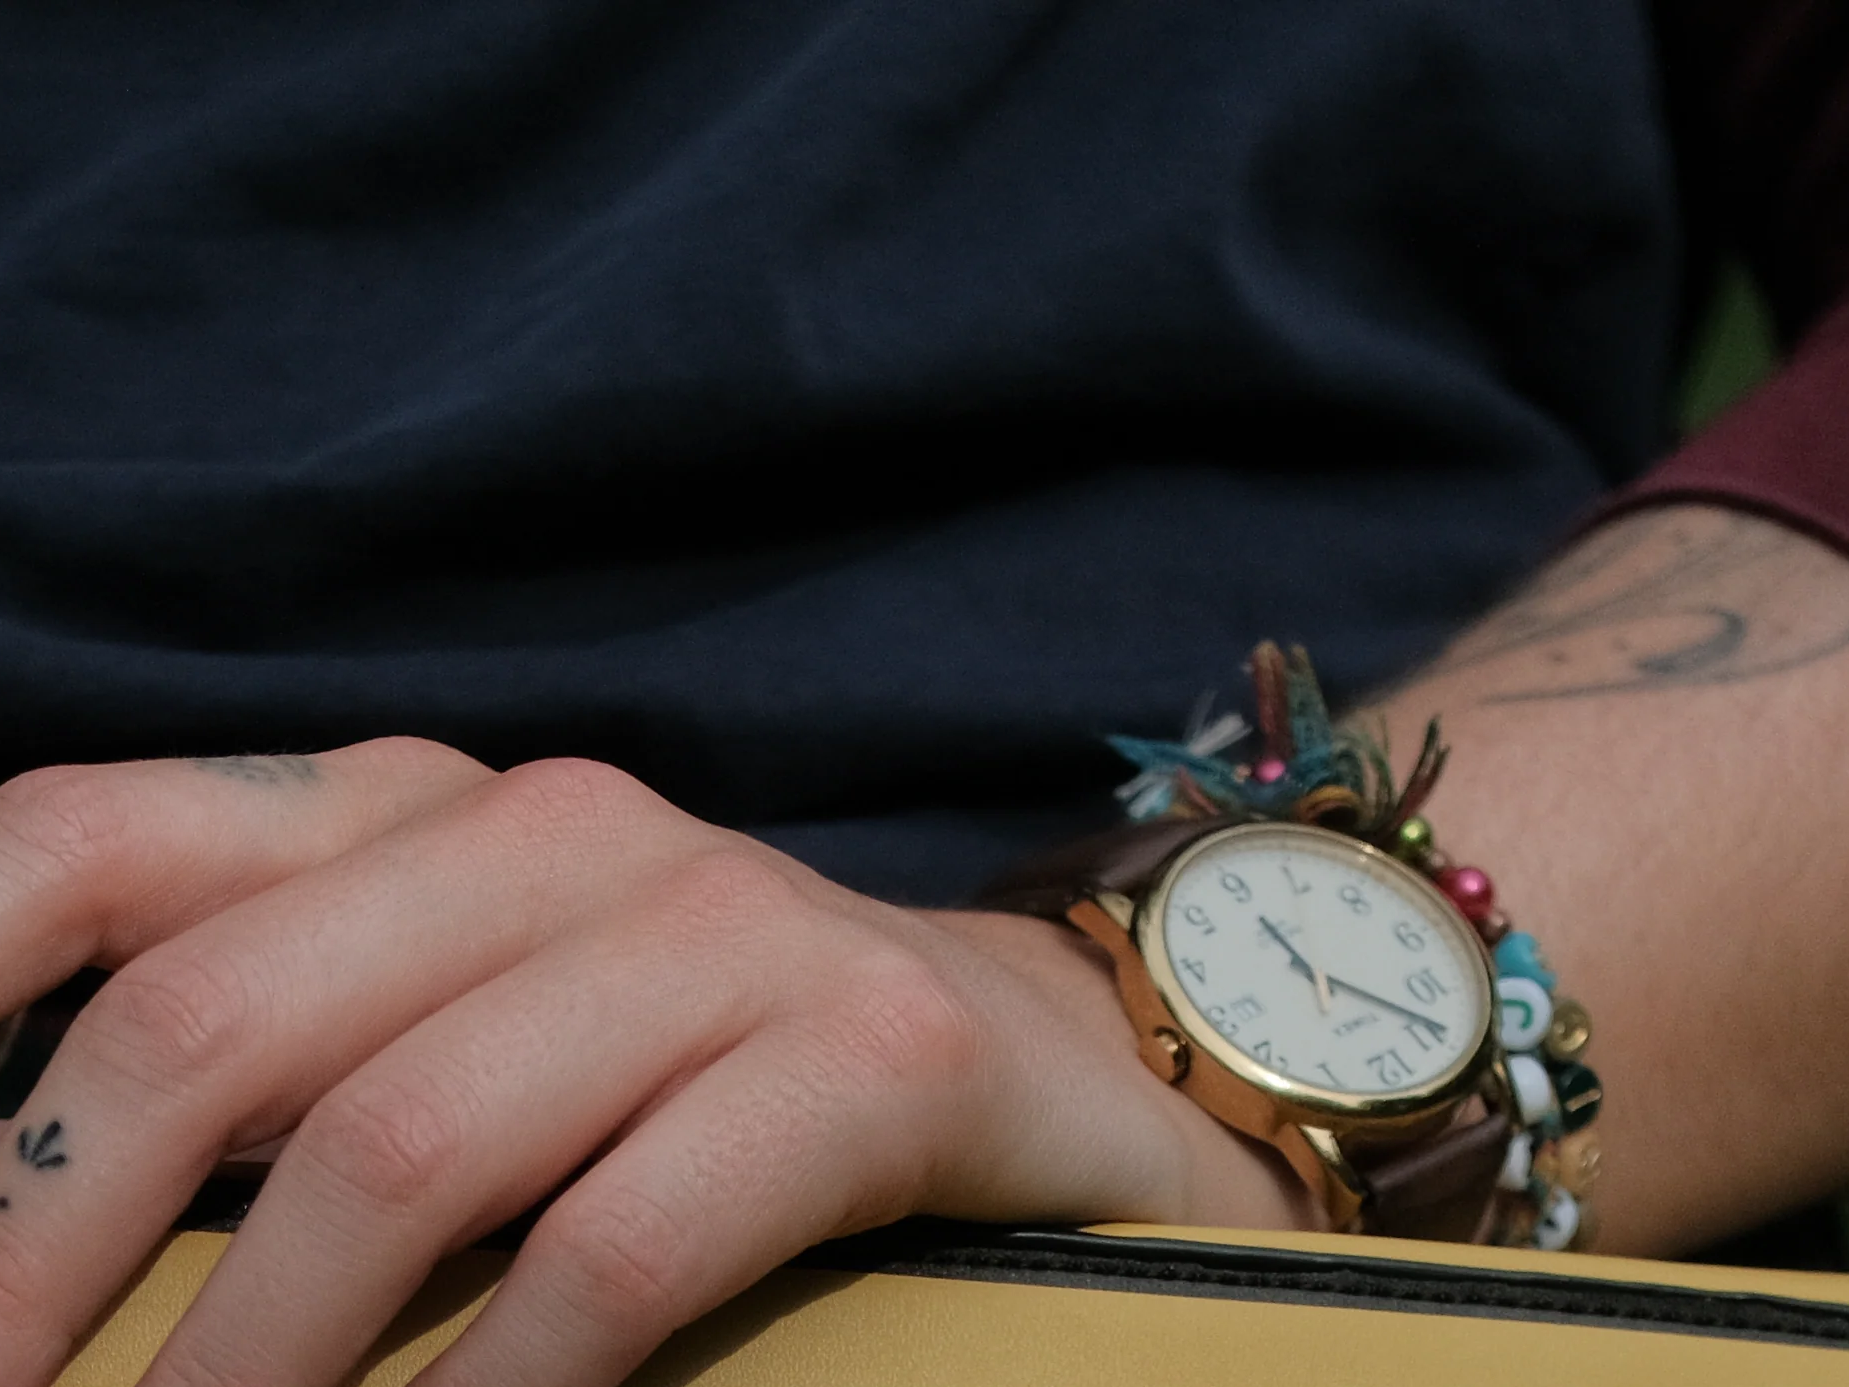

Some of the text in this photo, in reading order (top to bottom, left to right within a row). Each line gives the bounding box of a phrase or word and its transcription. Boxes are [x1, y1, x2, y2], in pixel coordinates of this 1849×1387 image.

[1220, 870, 1252, 903] 6
[1279, 865, 1312, 896] 7
[1339, 883, 1372, 915] 8
[1183, 904, 1216, 936] 5
[1394, 920, 1428, 953] 9
[1179, 955, 1208, 986] 4
[1404, 966, 1451, 1005] 10
[1204, 1003, 1240, 1038] 3
[1315, 1061, 1351, 1089] 1
[1366, 1047, 1417, 1087] 12
